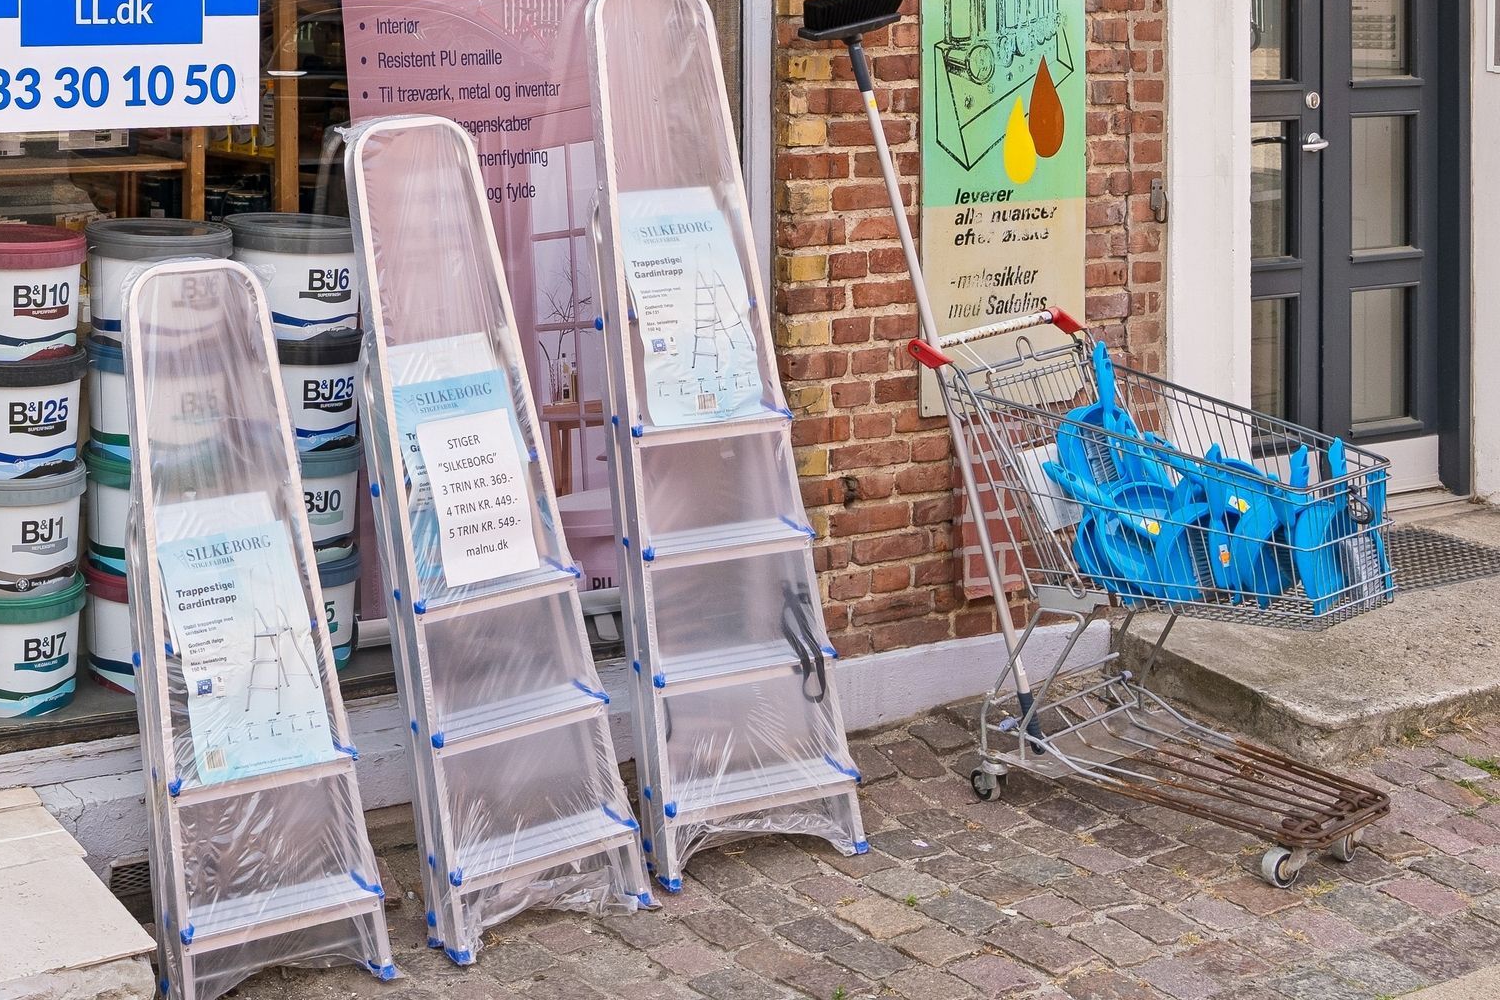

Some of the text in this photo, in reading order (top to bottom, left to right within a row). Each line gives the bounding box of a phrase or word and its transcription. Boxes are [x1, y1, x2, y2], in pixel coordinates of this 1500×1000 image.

[376, 17, 420, 35] Interiør
[378, 49, 502, 69] Resistent PU emaille
[53, 65, 110, 109] 30
[122, 64, 175, 107] 10
[183, 63, 236, 105] 50
[379, 81, 561, 104] Til træværk, metal og inventar
[486, 183, 536, 203] og fylde
[955, 187, 1014, 205] leverer
[639, 220, 713, 239] SILKEBORG
[634, 268, 684, 279] Gardintrapp
[985, 292, 1048, 315] Sadolins
[415, 382, 492, 407] SILKEBORG
[446, 434, 481, 450] STIGER
[442, 484, 449, 496] 3
[449, 481, 472, 494] TRIN
[473, 478, 490, 490] KR.
[490, 474, 514, 487] 369.-
[446, 494, 518, 517] 4 TRIN KR. 449.-
[449, 515, 522, 539] 5 TRIN KR. 549.-
[186, 534, 271, 562] SILKEBORG
[466, 538, 509, 558] malnu.dk
[178, 594, 237, 612] Gardintrapp
